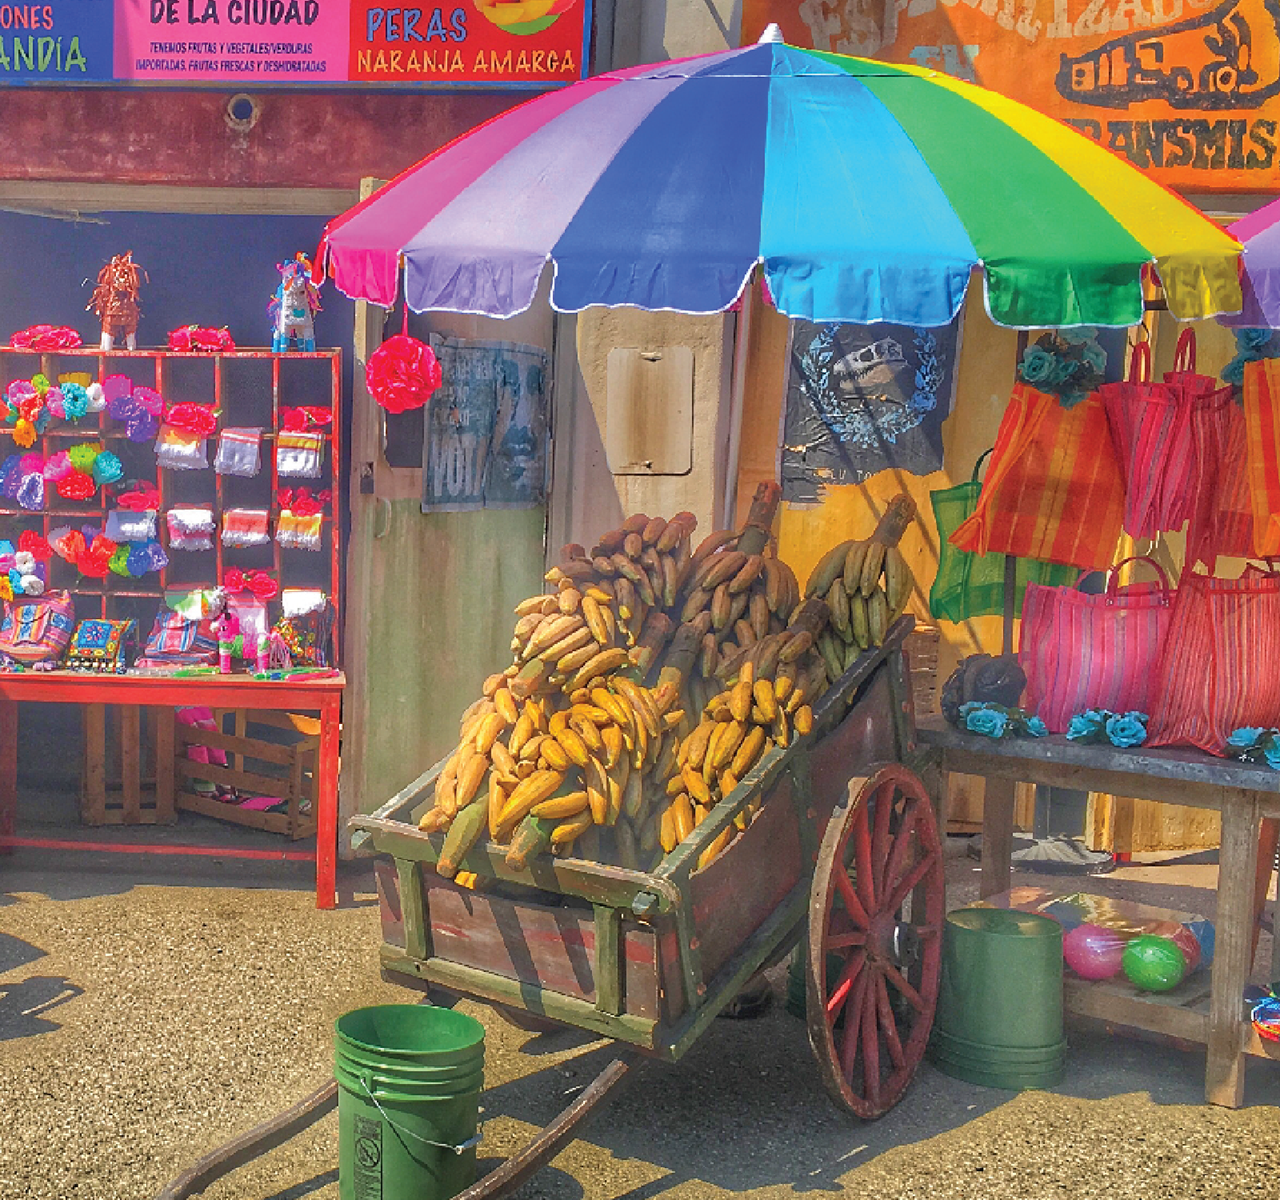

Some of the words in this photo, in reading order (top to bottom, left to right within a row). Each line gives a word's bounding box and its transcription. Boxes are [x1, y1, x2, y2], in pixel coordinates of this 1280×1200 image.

[366, 7, 468, 42] PERAS
[149, 41, 187, 54] TENEMOS
[189, 41, 217, 55] FRUTAS
[188, 59, 219, 72] FRUTAS
[220, 59, 255, 72] FRESCAS
[263, 59, 327, 73] DESHIDRATADAS
[356, 49, 465, 74] NARANJA
[472, 49, 576, 74] AMARGA
